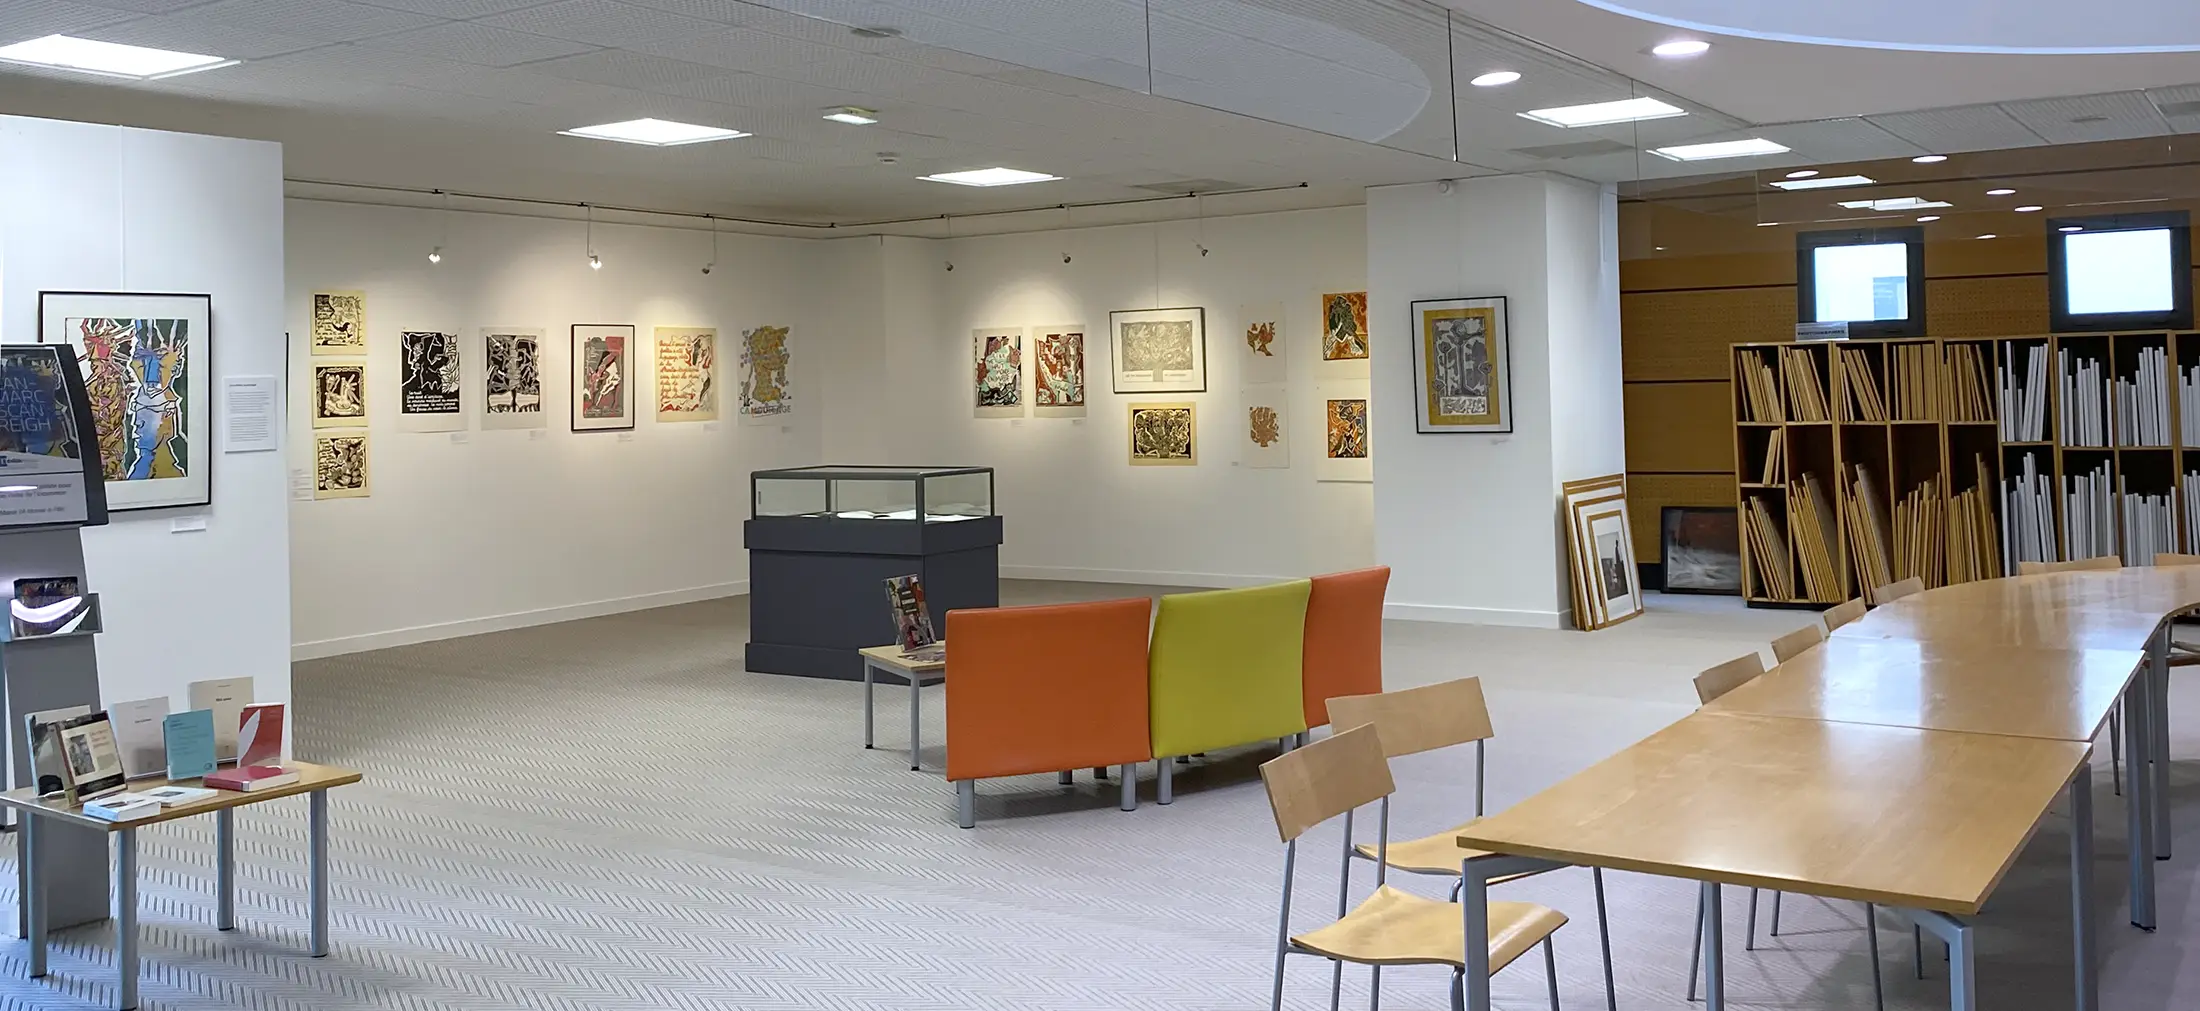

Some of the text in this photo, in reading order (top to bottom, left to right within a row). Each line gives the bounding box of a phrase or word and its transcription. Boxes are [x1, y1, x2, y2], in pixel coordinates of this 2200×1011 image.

[0, 377, 37, 390] AN-
[0, 403, 45, 418] SCAN
[0, 417, 51, 432] REIGH
